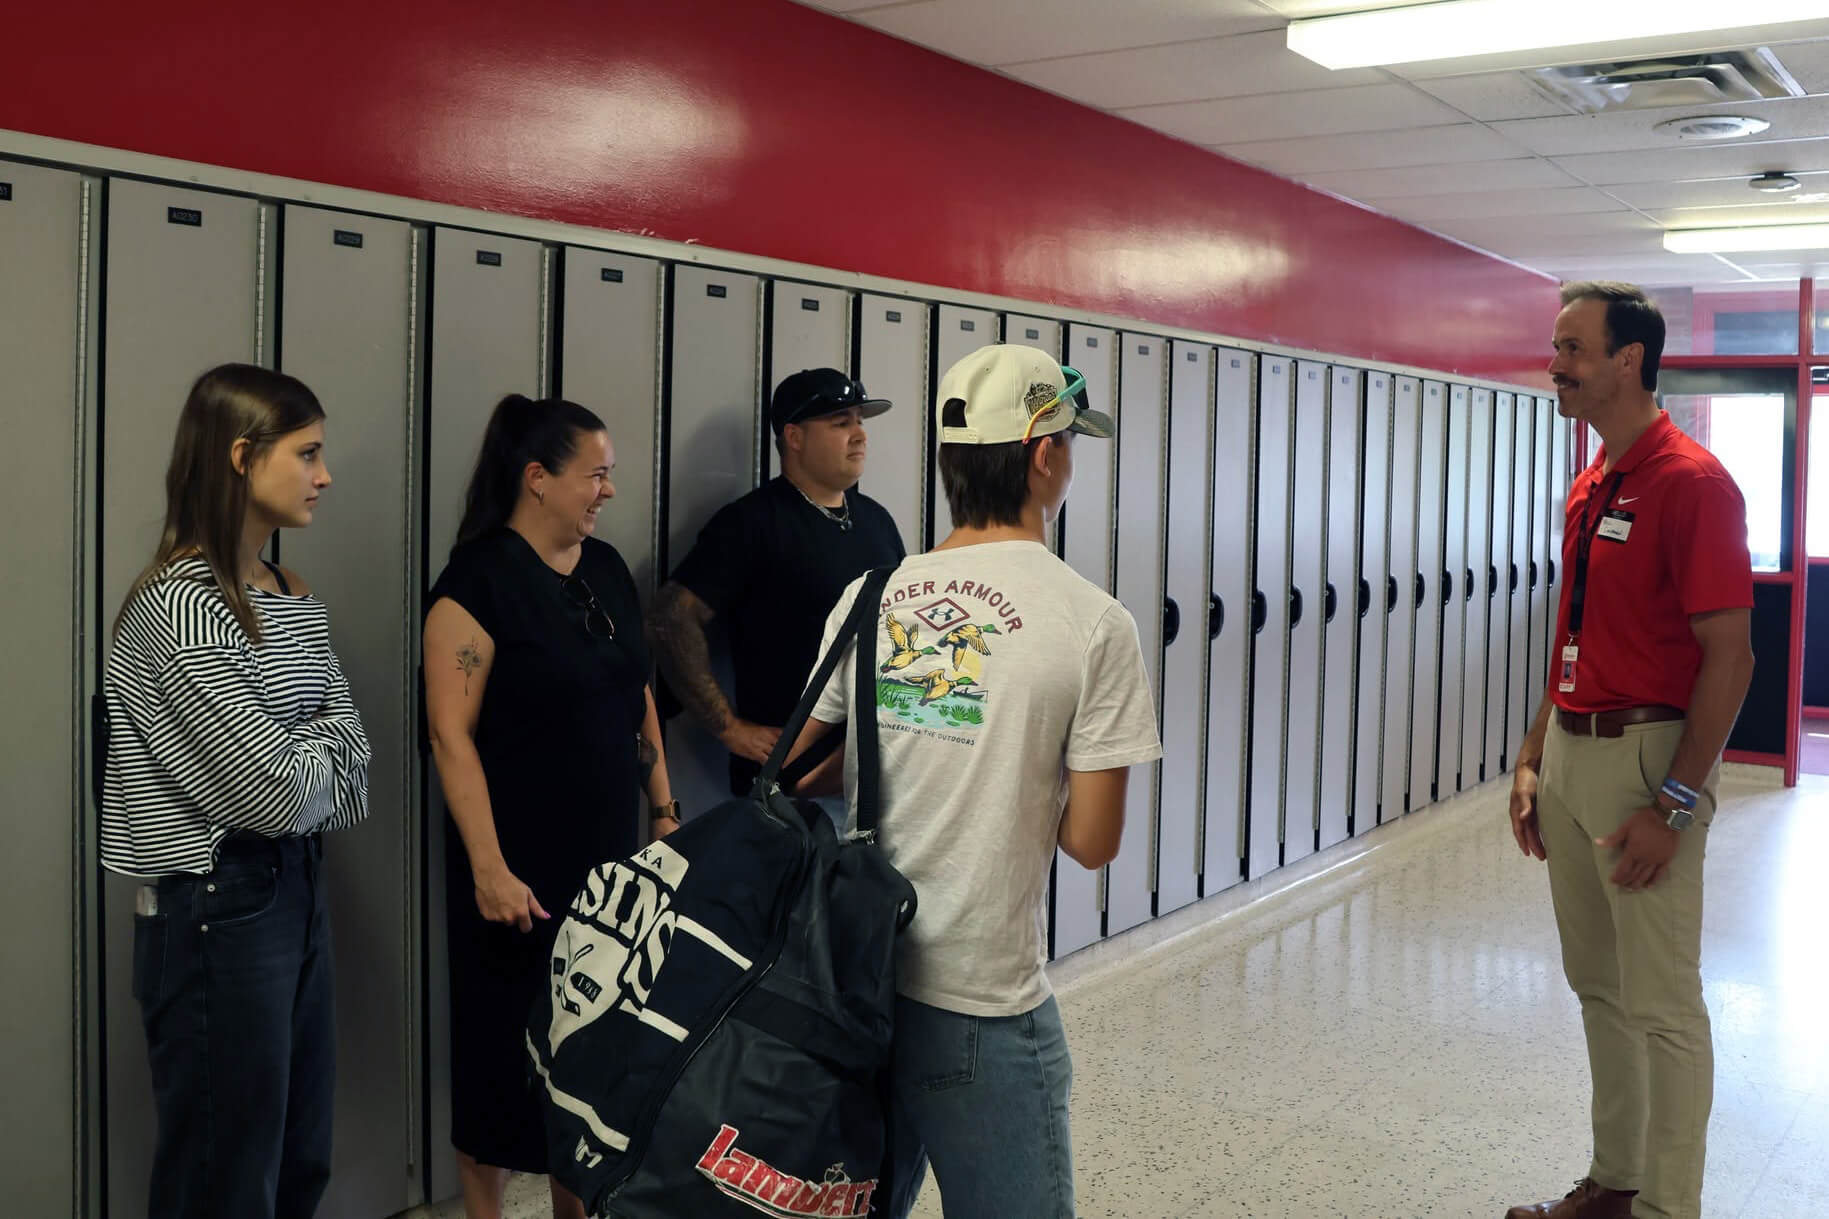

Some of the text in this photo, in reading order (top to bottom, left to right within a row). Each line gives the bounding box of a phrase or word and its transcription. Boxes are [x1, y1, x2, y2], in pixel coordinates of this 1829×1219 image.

[880, 580, 1023, 633] NDER ARMOUR
[924, 730, 936, 738] THE
[938, 732, 976, 746] OUTDOORS
